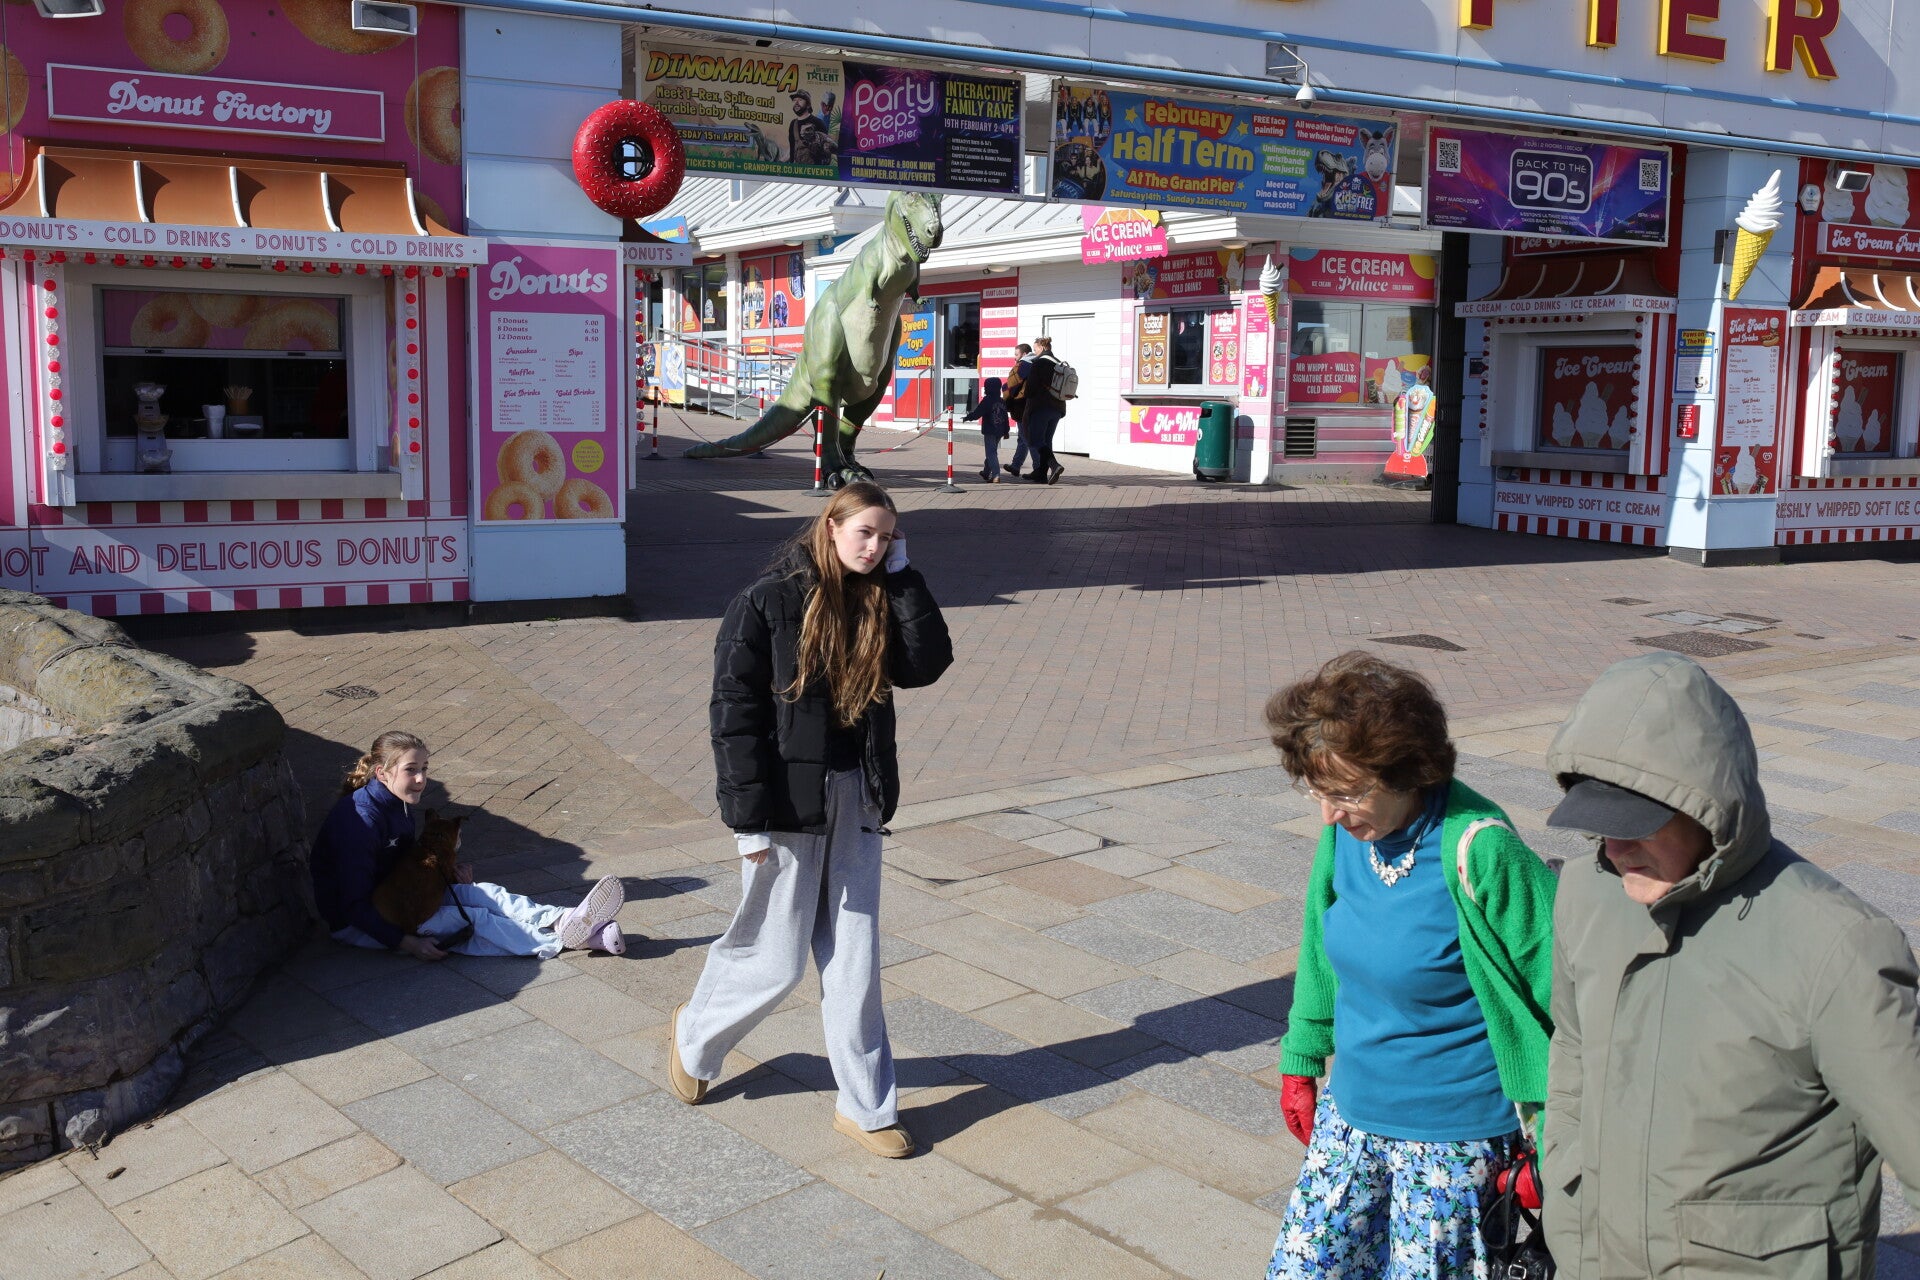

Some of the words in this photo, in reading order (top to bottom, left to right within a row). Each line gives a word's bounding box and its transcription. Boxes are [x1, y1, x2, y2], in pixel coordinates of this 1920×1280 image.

[645, 51, 799, 92] DINOMANIA
[656, 86, 682, 99] Meet
[685, 87, 722, 103] T-Rex,
[724, 90, 753, 106] Spike
[756, 96, 775, 108] and
[855, 76, 935, 116] Party
[945, 80, 1014, 103] INTERACTIVE
[107, 78, 206, 117] Donut
[213, 90, 332, 134] Factory
[945, 98, 984, 116] FAMILY
[986, 101, 1014, 120] RAVE
[699, 105, 726, 120] baby
[728, 107, 783, 125] dinosaurs!
[857, 109, 916, 135] Peeps
[1145, 103, 1232, 134] February
[1254, 116, 1270, 124] FREE
[1271, 117, 1286, 125] face
[944, 118, 959, 128] 19TH
[960, 120, 992, 132] FEBRUARY
[1254, 125, 1284, 136] painting
[1295, 120, 1304, 128] All
[1306, 122, 1333, 131] weather
[1334, 125, 1345, 133] fun
[1346, 126, 1356, 135] for
[677, 129, 701, 140] ESDAY
[723, 132, 748, 143] APRIL
[859, 137, 875, 148] On
[877, 133, 895, 145] The
[898, 129, 917, 140] Pier
[1297, 130, 1309, 138] the
[1310, 131, 1330, 140] whole
[1331, 134, 1352, 145] family
[1113, 128, 1176, 163] Half
[1179, 130, 1254, 171] Term
[1263, 145, 1296, 156] Unlimited
[1296, 148, 1310, 157] ride
[851, 156, 865, 166] FIND
[866, 157, 877, 167] OUT
[878, 158, 895, 168] MORE
[901, 160, 918, 170] BOOK
[1267, 155, 1305, 165] wristbands
[1516, 159, 1549, 169] BACK
[1553, 161, 1566, 171] TO
[1569, 163, 1586, 174] THE
[686, 159, 715, 169] TICKETS
[718, 161, 735, 170] NOW!
[744, 163, 834, 177] GRANDPIER.CO.UK/EVENTS
[852, 167, 936, 182] GRANDPIER.CO.UK/EVENTS
[1264, 164, 1280, 172] from
[1127, 170, 1143, 185] At
[1144, 173, 1168, 188] The
[1170, 176, 1209, 192] Grand
[1210, 180, 1235, 193] Pier
[1266, 181, 1284, 189] Meet
[1516, 170, 1585, 204] 90s
[1110, 189, 1146, 201] Saturday
[1167, 194, 1196, 204] Sunday
[1196, 196, 1214, 205] 22nd
[1215, 198, 1247, 209] February
[1256, 189, 1271, 197] Dino
[1272, 190, 1278, 198] &
[1279, 191, 1305, 201] Donkey
[1264, 201, 1295, 209] mascots!
[1357, 196, 1374, 211] FREE
[1091, 226, 1110, 243] ICE
[1111, 221, 1153, 241] CREAM
[0, 221, 78, 241] DONUTS
[104, 226, 158, 245] COLD
[166, 230, 231, 249] DRINKS
[256, 235, 328, 253] DONUTS
[350, 239, 398, 256] COLD
[406, 241, 465, 259] DRINKS
[1832, 229, 1851, 248] Ice
[1854, 231, 1894, 251] Cream
[1104, 243, 1142, 259] Palace
[1172, 259, 1190, 269] WHIPPY
[1196, 256, 1213, 266] WALL'S
[1321, 257, 1347, 274] ICE
[1351, 258, 1405, 277] CREAM
[488, 256, 608, 301] Donuts
[1160, 271, 1185, 283] SIGNATURE
[1186, 270, 1194, 279] ICE
[1195, 269, 1215, 278] CREAMS
[1336, 275, 1389, 292] Palace
[1172, 284, 1184, 294] COLD
[1185, 282, 1202, 293] DRINKS
[1462, 304, 1473, 314] ICE
[1476, 303, 1501, 313] CREAM
[1510, 302, 1531, 312] COLD
[1534, 300, 1560, 310] DRINKS
[1570, 299, 1583, 309] ICE
[1587, 298, 1616, 308] CREAM
[1632, 298, 1643, 308] ICE
[1646, 299, 1670, 310] CREAM
[1747, 317, 1768, 333] Food
[1809, 312, 1839, 323] CREAM
[1852, 312, 1862, 322] ICE
[1865, 313, 1887, 322] CREAM
[1894, 314, 1911, 324] COLD
[903, 319, 928, 333] Sweets
[506, 347, 537, 355] Pancakes
[907, 338, 923, 351] Toys
[568, 348, 583, 357] Dips
[898, 354, 932, 368] Souvenirs
[1296, 363, 1305, 372] MR
[1307, 363, 1328, 371] WHIPPY
[1335, 363, 1355, 372] WALL'S
[1554, 357, 1580, 380] Ice
[1581, 355, 1635, 378] Cream
[508, 368, 535, 376] Waffles
[1842, 359, 1888, 381] Cream
[1292, 373, 1322, 382] SIGNATURE
[1324, 374, 1332, 382] ICE
[1334, 374, 1357, 383] CREAMS
[518, 389, 540, 397] Drinks
[556, 389, 572, 397] Cold
[573, 388, 595, 396] Drinks
[1307, 385, 1320, 394] COLD
[1322, 385, 1342, 394] DRINKS
[1153, 413, 1175, 434] Mr
[1497, 491, 1531, 505] FRESHLY
[1535, 494, 1574, 509] WHIPPED
[1578, 499, 1602, 511] SOFT
[1606, 500, 1620, 513] ICE
[1625, 502, 1660, 516] CREAM
[1816, 501, 1861, 517] WHIPPED
[1865, 500, 1891, 516] SOFT
[1894, 500, 1911, 515] ICE
[0, 547, 50, 577] OT
[69, 544, 141, 575] AND
[157, 538, 322, 572] DELICIOUS
[337, 535, 456, 567] DONUTS
